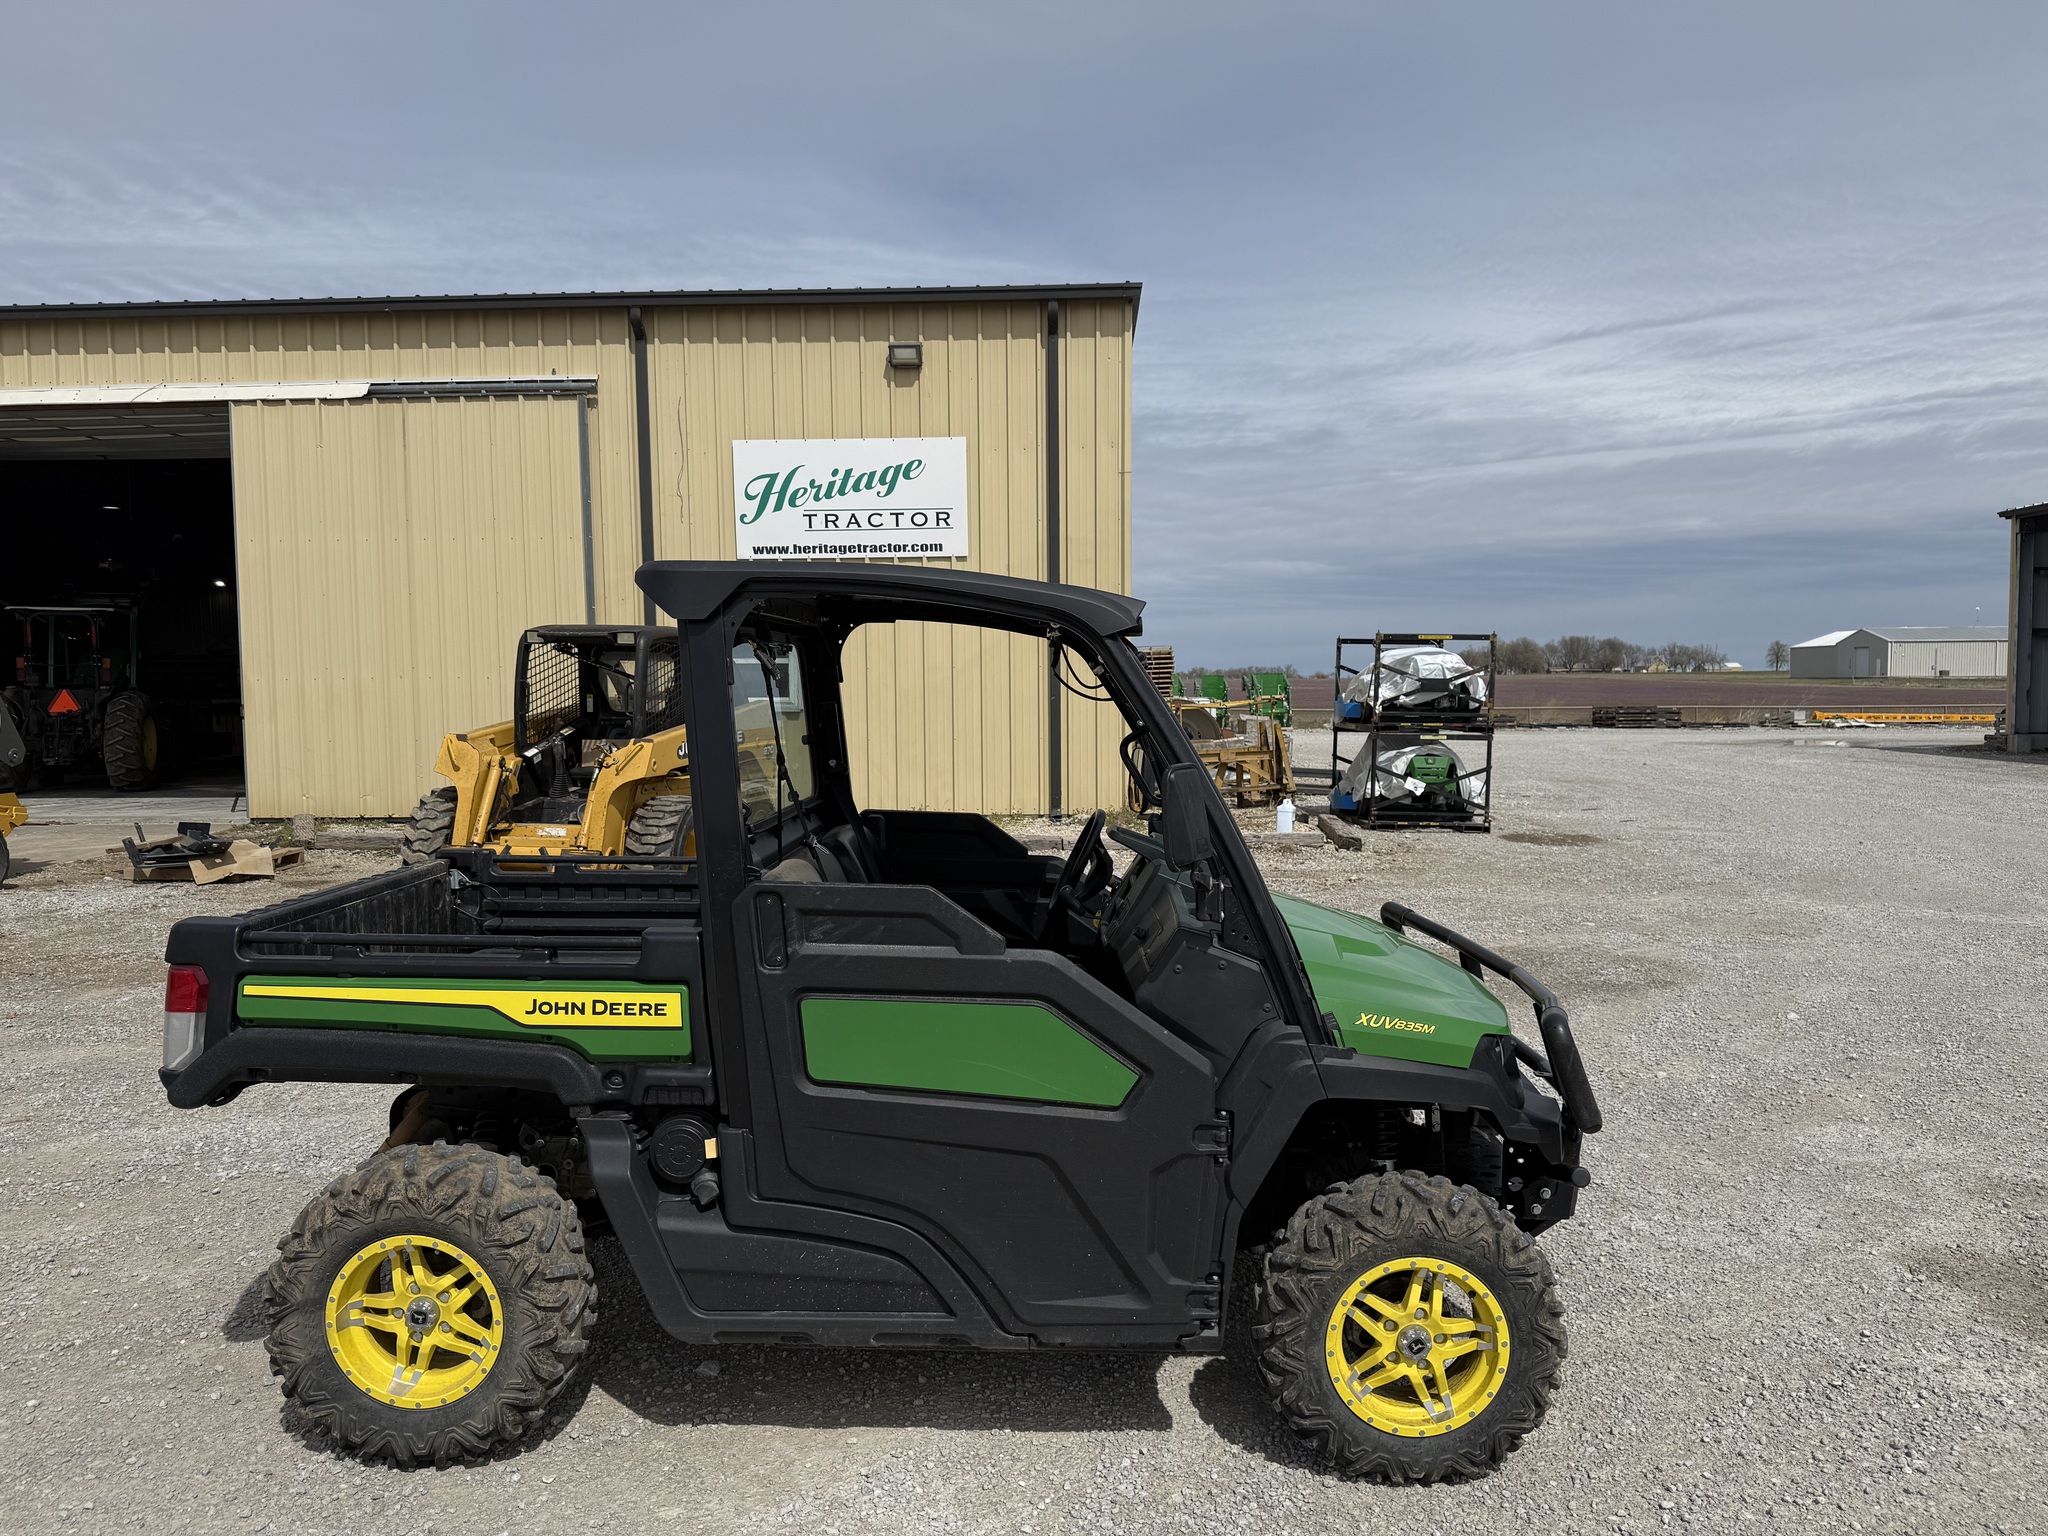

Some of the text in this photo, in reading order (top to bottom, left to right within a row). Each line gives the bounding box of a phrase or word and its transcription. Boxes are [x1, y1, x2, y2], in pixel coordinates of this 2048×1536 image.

[739, 458, 927, 525] Heritage
[802, 511, 952, 529] TRACTOR
[752, 542, 944, 555] www.heritagetractor.com
[524, 998, 668, 1017] JOHN DEERE
[1354, 1012, 1436, 1034] XUV835M
